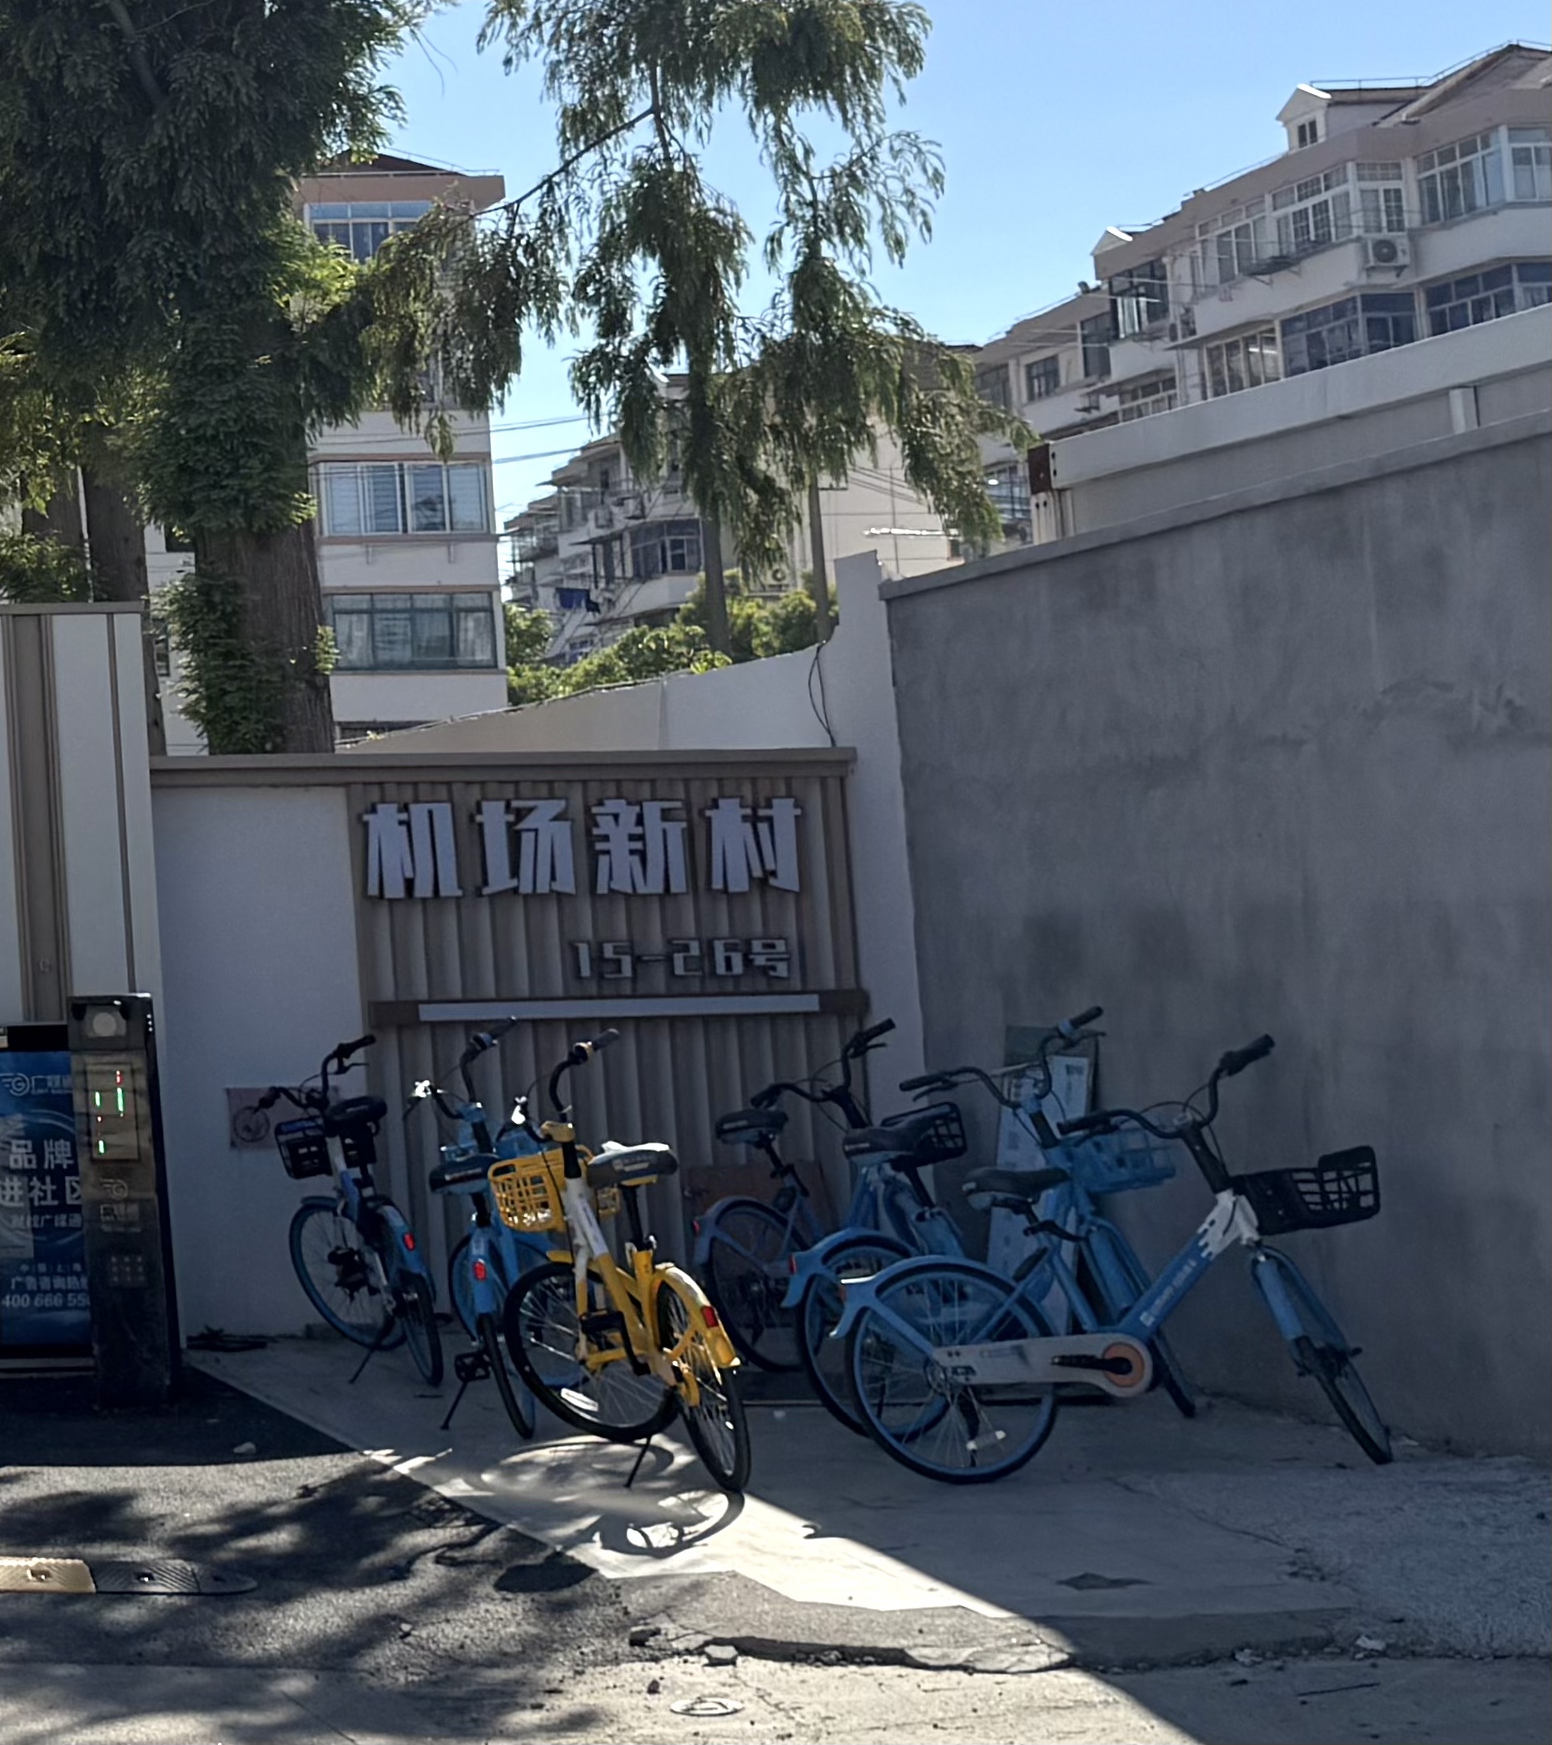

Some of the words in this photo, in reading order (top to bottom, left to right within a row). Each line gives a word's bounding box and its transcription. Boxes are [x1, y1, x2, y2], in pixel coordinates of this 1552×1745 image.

[363, 797, 801, 898] 机场新村
[573, 938, 789, 979] 15-26号
[9, 1139, 74, 1169] 品牌
[1, 1293, 30, 1308] 400
[34, 1292, 63, 1307] 666
